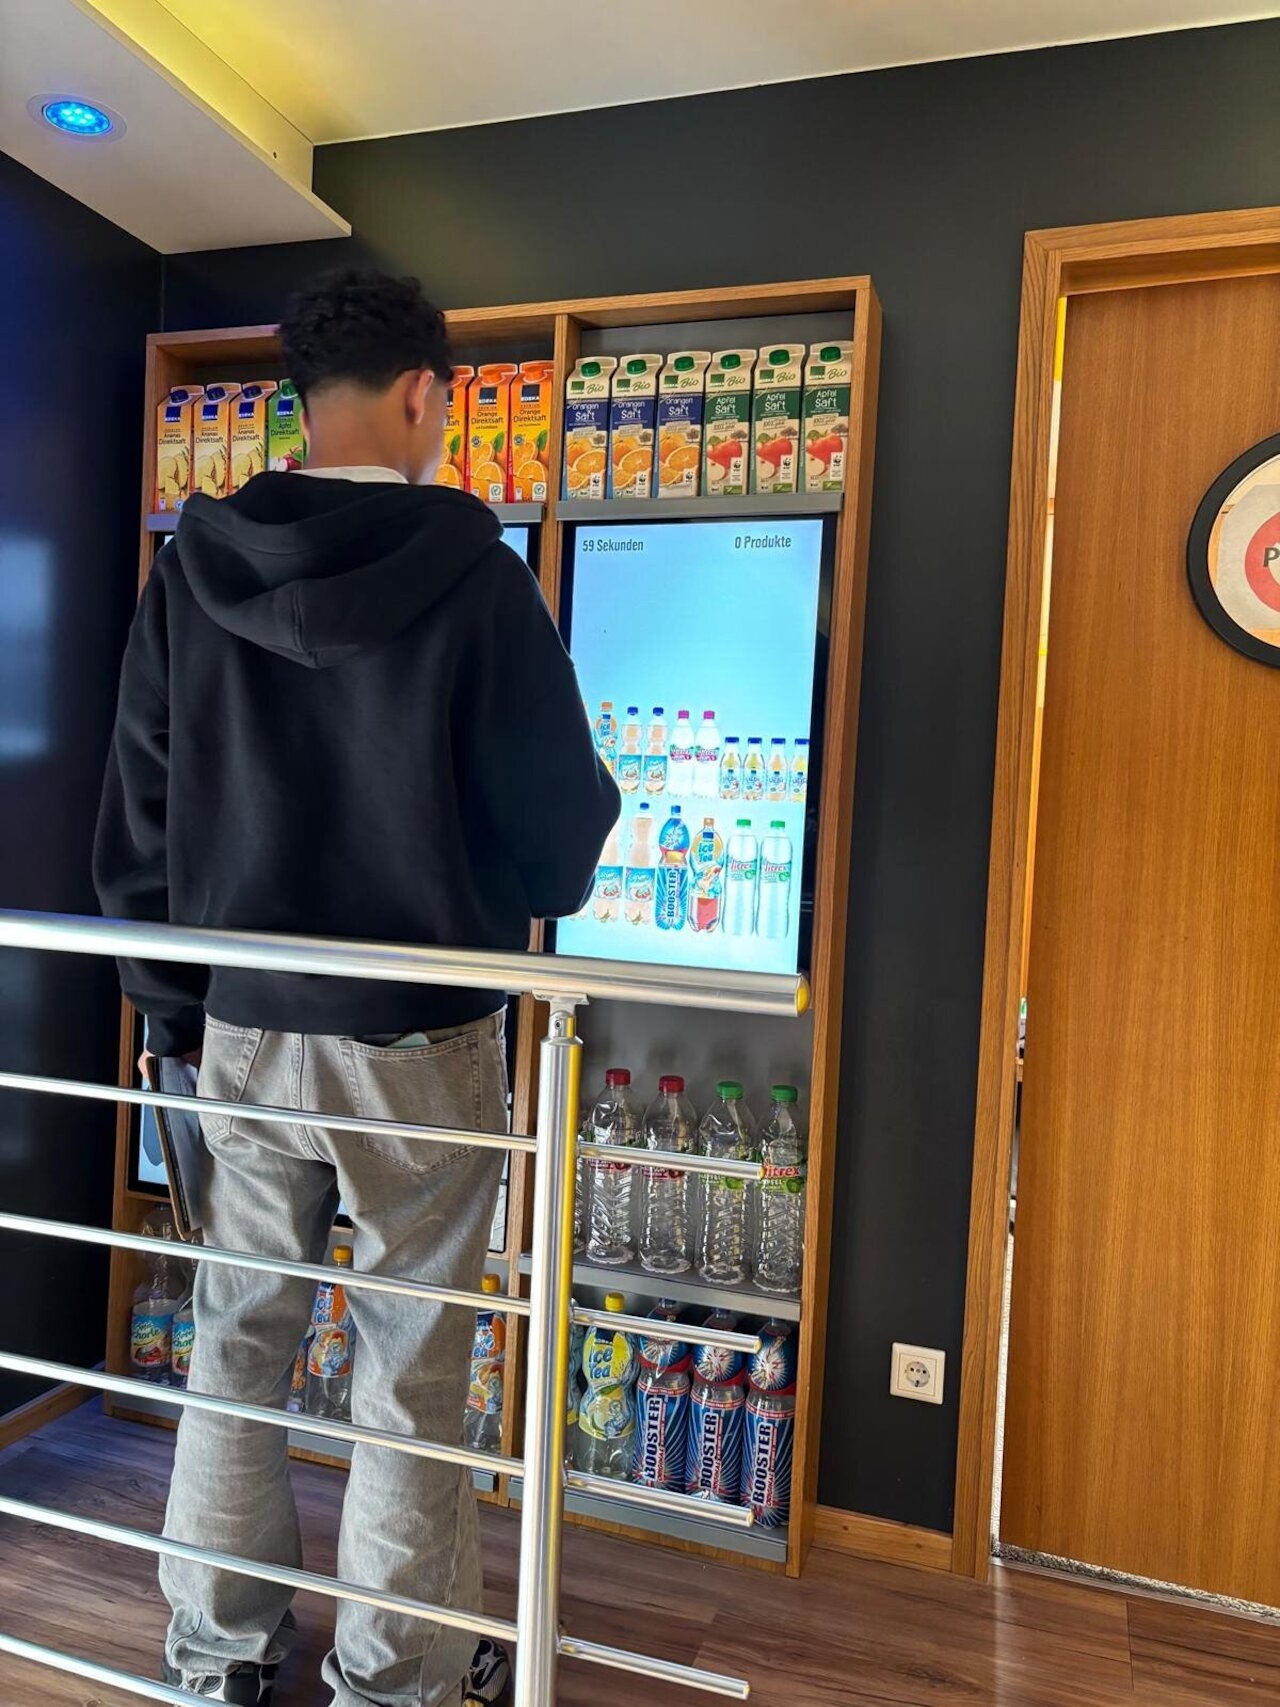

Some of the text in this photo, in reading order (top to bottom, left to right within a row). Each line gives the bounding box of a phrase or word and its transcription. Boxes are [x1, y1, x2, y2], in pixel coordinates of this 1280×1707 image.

[776, 372, 796, 383] Bio
[827, 368, 848, 379] Bio
[681, 378, 699, 388] Bio
[726, 375, 746, 386] Bio
[586, 384, 604, 394] Bio
[632, 382, 651, 392] Bio
[764, 401, 786, 411] Saft
[815, 398, 837, 408] Saft
[519, 409, 541, 417] Orange
[621, 409, 641, 419] Saft
[668, 406, 689, 417] Saft
[714, 405, 736, 415] Saft
[470, 417, 504, 425] Direktsaft
[513, 415, 547, 424] Direktsaft
[575, 411, 596, 421] Saft
[582, 539, 644, 552] 59 Sekunden
[735, 535, 792, 549] 0 Produkte
[667, 871, 677, 917] BOOSTER
[645, 1398, 661, 1479] BOOSTER
[701, 1414, 717, 1489] BOOSTER
[752, 1423, 771, 1504] BOOSTER
